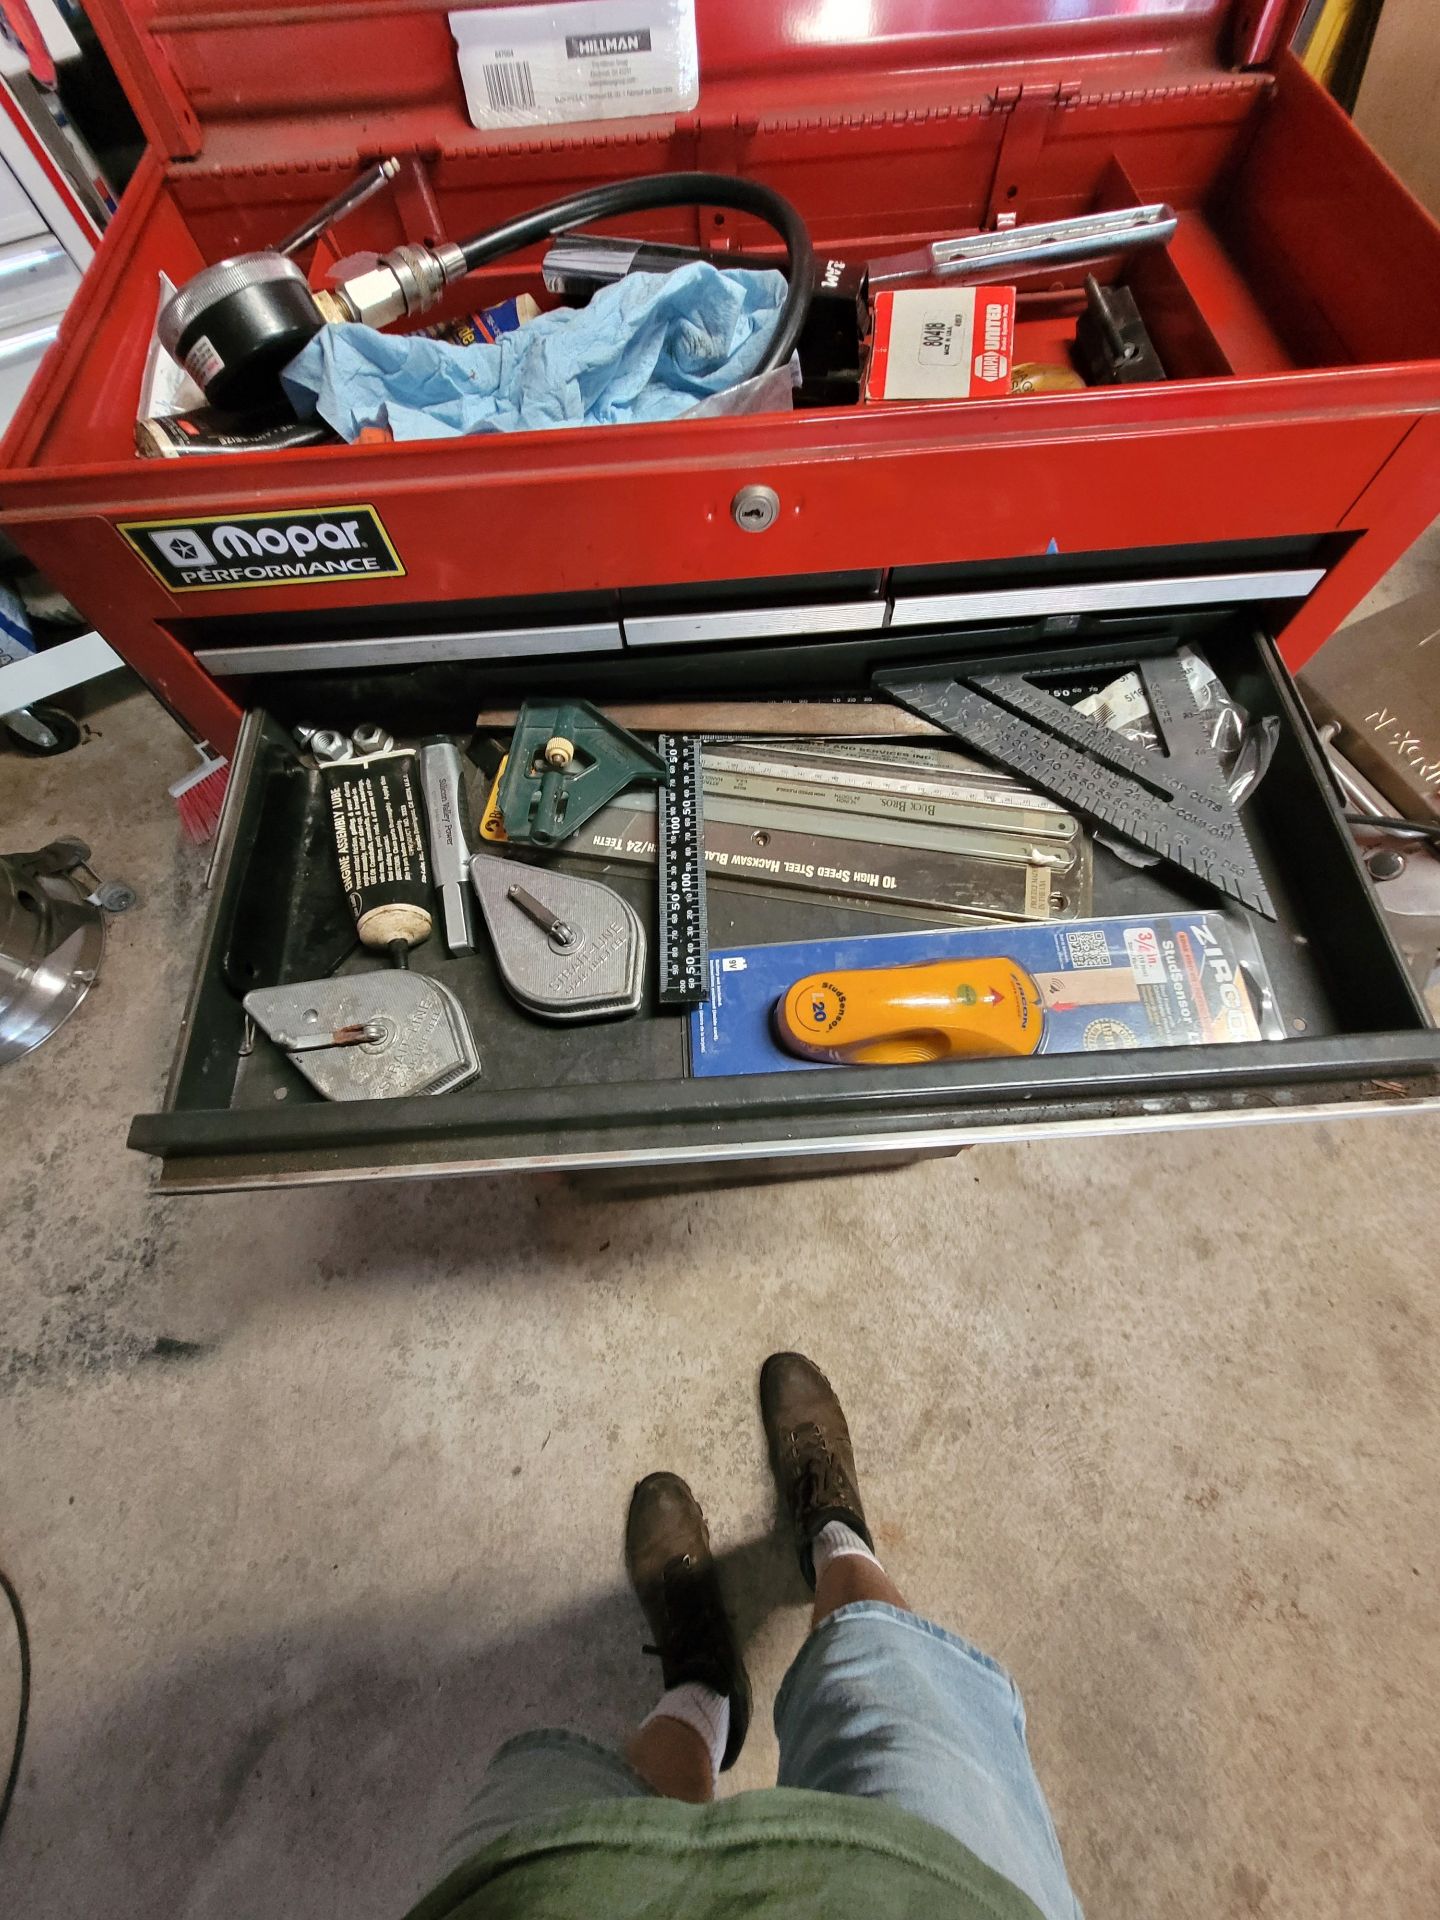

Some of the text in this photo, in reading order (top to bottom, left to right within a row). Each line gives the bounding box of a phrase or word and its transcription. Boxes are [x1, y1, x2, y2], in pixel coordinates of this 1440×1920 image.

[579, 36, 639, 54] HILLMAN
[923, 322, 945, 347] 80418
[983, 304, 1002, 378] NAPA UNITED
[212, 520, 361, 559] Mopar
[181, 557, 381, 584] PERFORMANCE
[1124, 689, 1145, 702] 5/16
[669, 749, 678, 763] 50
[683, 748, 689, 757] 10
[859, 747, 909, 758] SERVICES
[683, 762, 689, 771] 20
[1045, 758, 1061, 770] 40
[1079, 778, 1095, 790] 50
[669, 778, 676, 788] 70
[683, 776, 689, 785] 30
[684, 789, 690, 798] 40
[1189, 790, 1223, 812] CUTS
[438, 778, 453, 846] Silicon Valley Power
[683, 800, 691, 815] 50
[880, 798, 936, 816] BUCK BROS.
[671, 817, 680, 835] 100
[330, 787, 353, 892] ENGINE ASSEMBLY LUBE
[593, 835, 622, 850] TEETH
[684, 832, 691, 842] 70
[670, 850, 677, 860] 20
[671, 866, 677, 876] 30
[685, 862, 692, 872] 90
[731, 855, 780, 873] HACKSAW
[784, 862, 815, 878] STEEL
[817, 866, 850, 883] SPEED
[853, 872, 879, 887] HIGH
[671, 881, 677, 891] 40
[682, 873, 691, 892] 100
[882, 876, 897, 889] 10
[671, 894, 680, 910] 50
[672, 913, 678, 924] 60
[687, 910, 693, 920] 20
[672, 930, 679, 940] 70
[687, 926, 694, 937] 30
[549, 921, 623, 991] STRAIT-LINE
[687, 943, 694, 954] 40
[672, 964, 679, 975] 90
[686, 957, 696, 975] 50
[728, 960, 737, 969] 9V
[1162, 940, 1192, 1024] StudSensor
[812, 992, 827, 1022] L20
[822, 982, 847, 1033] StudSensor
[380, 999, 432, 1091] STRAIT-LINE
